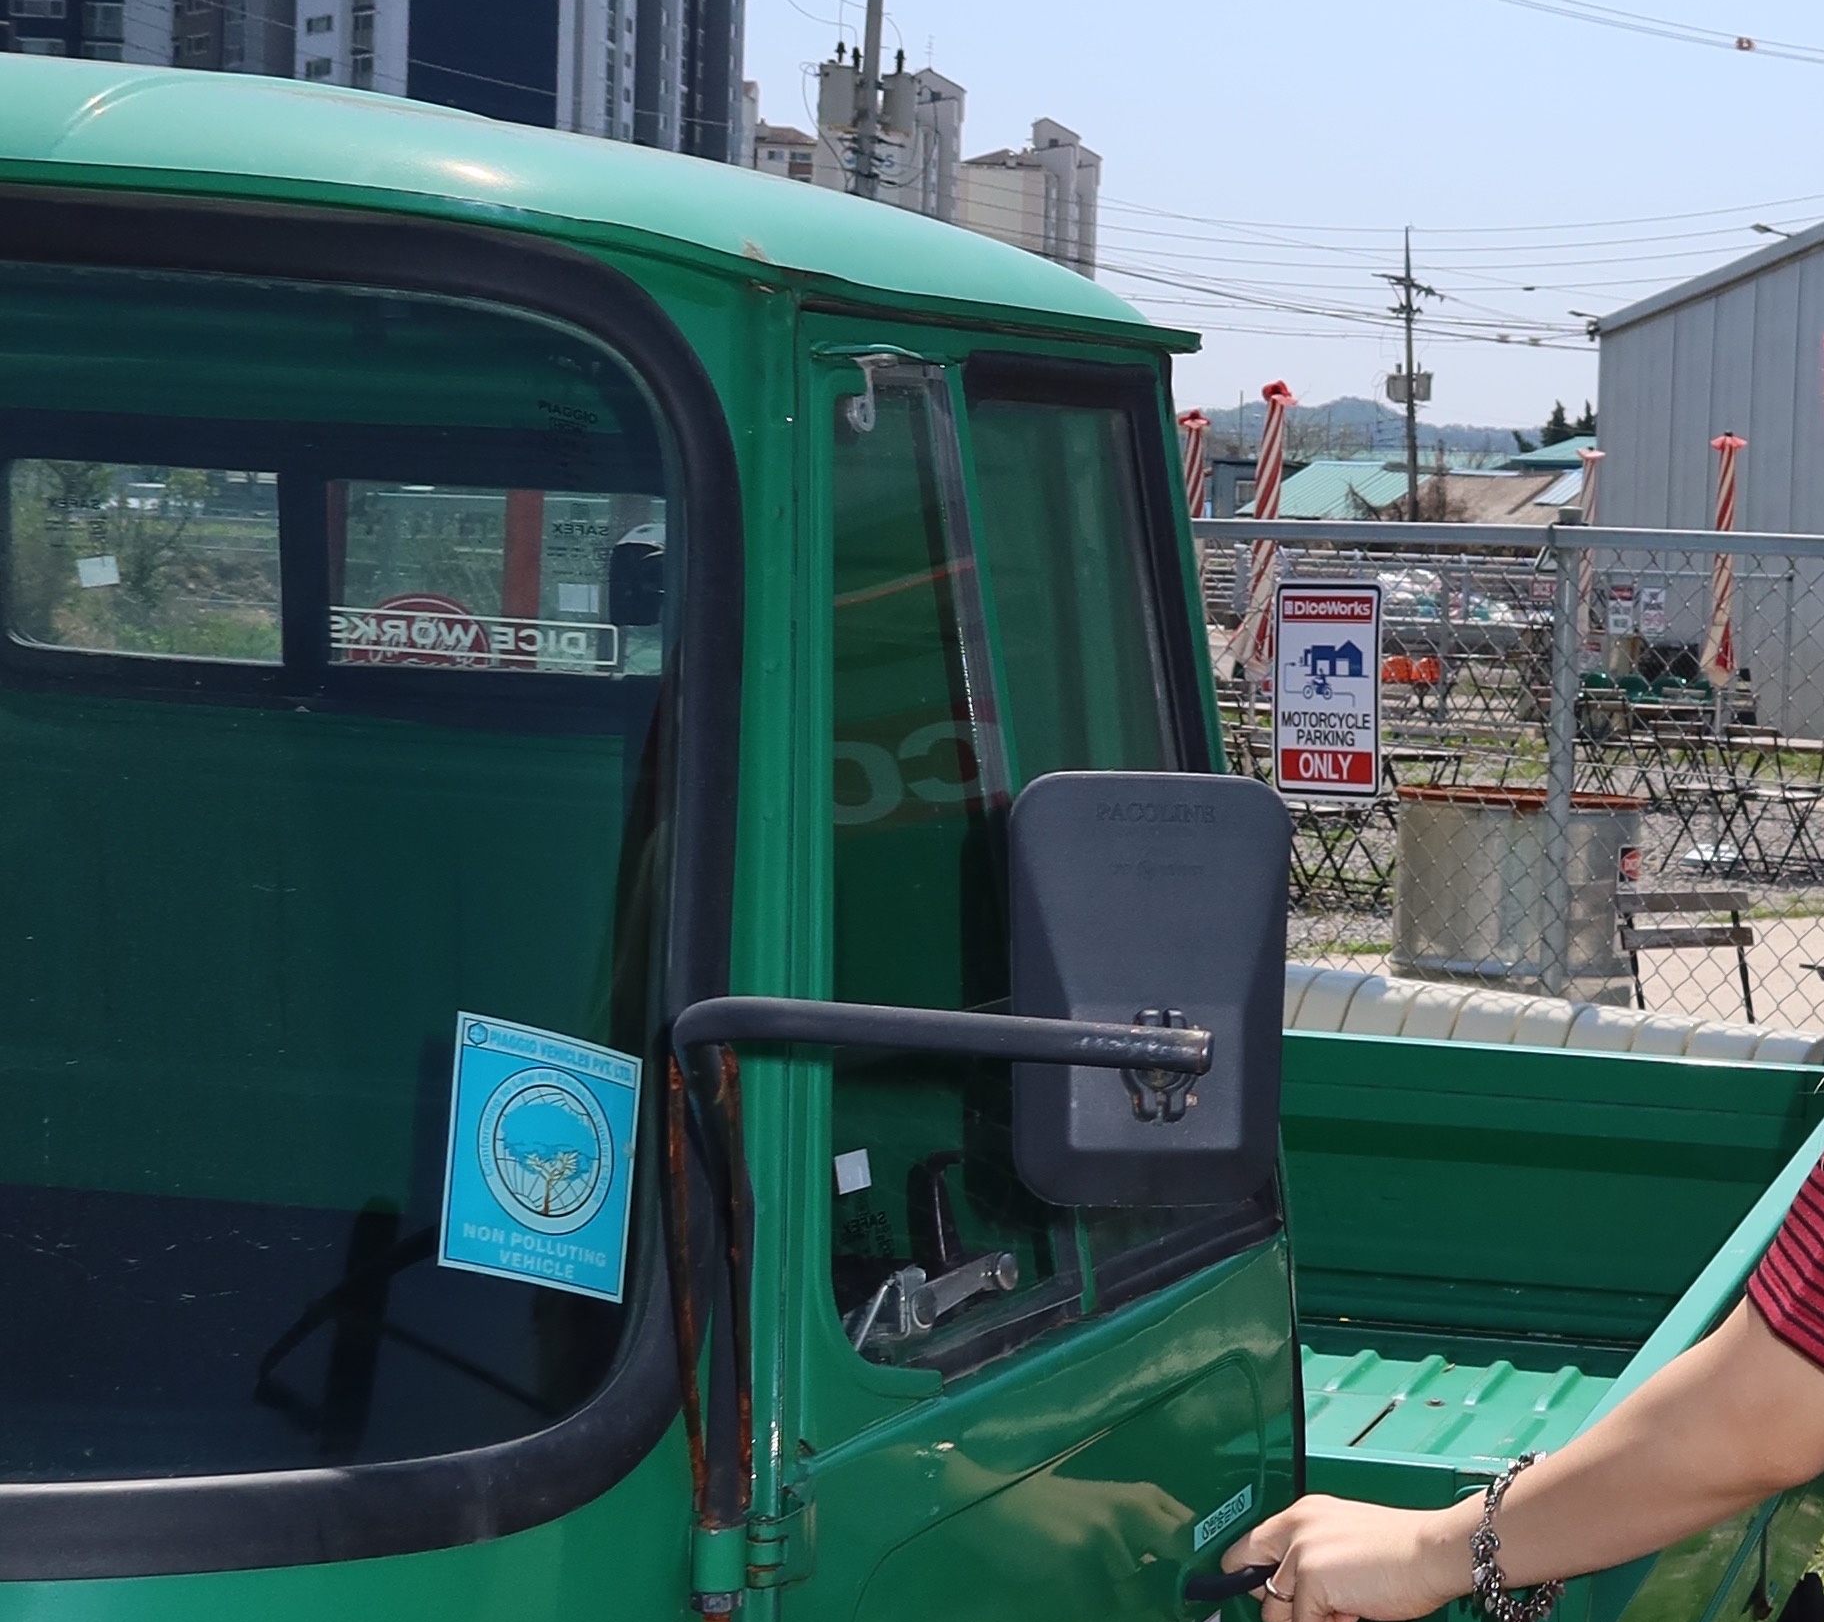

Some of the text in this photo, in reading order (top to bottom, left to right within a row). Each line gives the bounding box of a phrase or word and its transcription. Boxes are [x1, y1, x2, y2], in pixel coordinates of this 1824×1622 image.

[538, 399, 598, 425] PIAGGIO
[1281, 711, 1371, 730] MOTORCYCLE
[1296, 729, 1355, 747] PARKING
[1299, 752, 1353, 780] ONLY
[540, 1042, 590, 1070] VEHICLES
[463, 1223, 606, 1267] NON POLLUTING
[499, 1249, 575, 1279] VEHICLE
